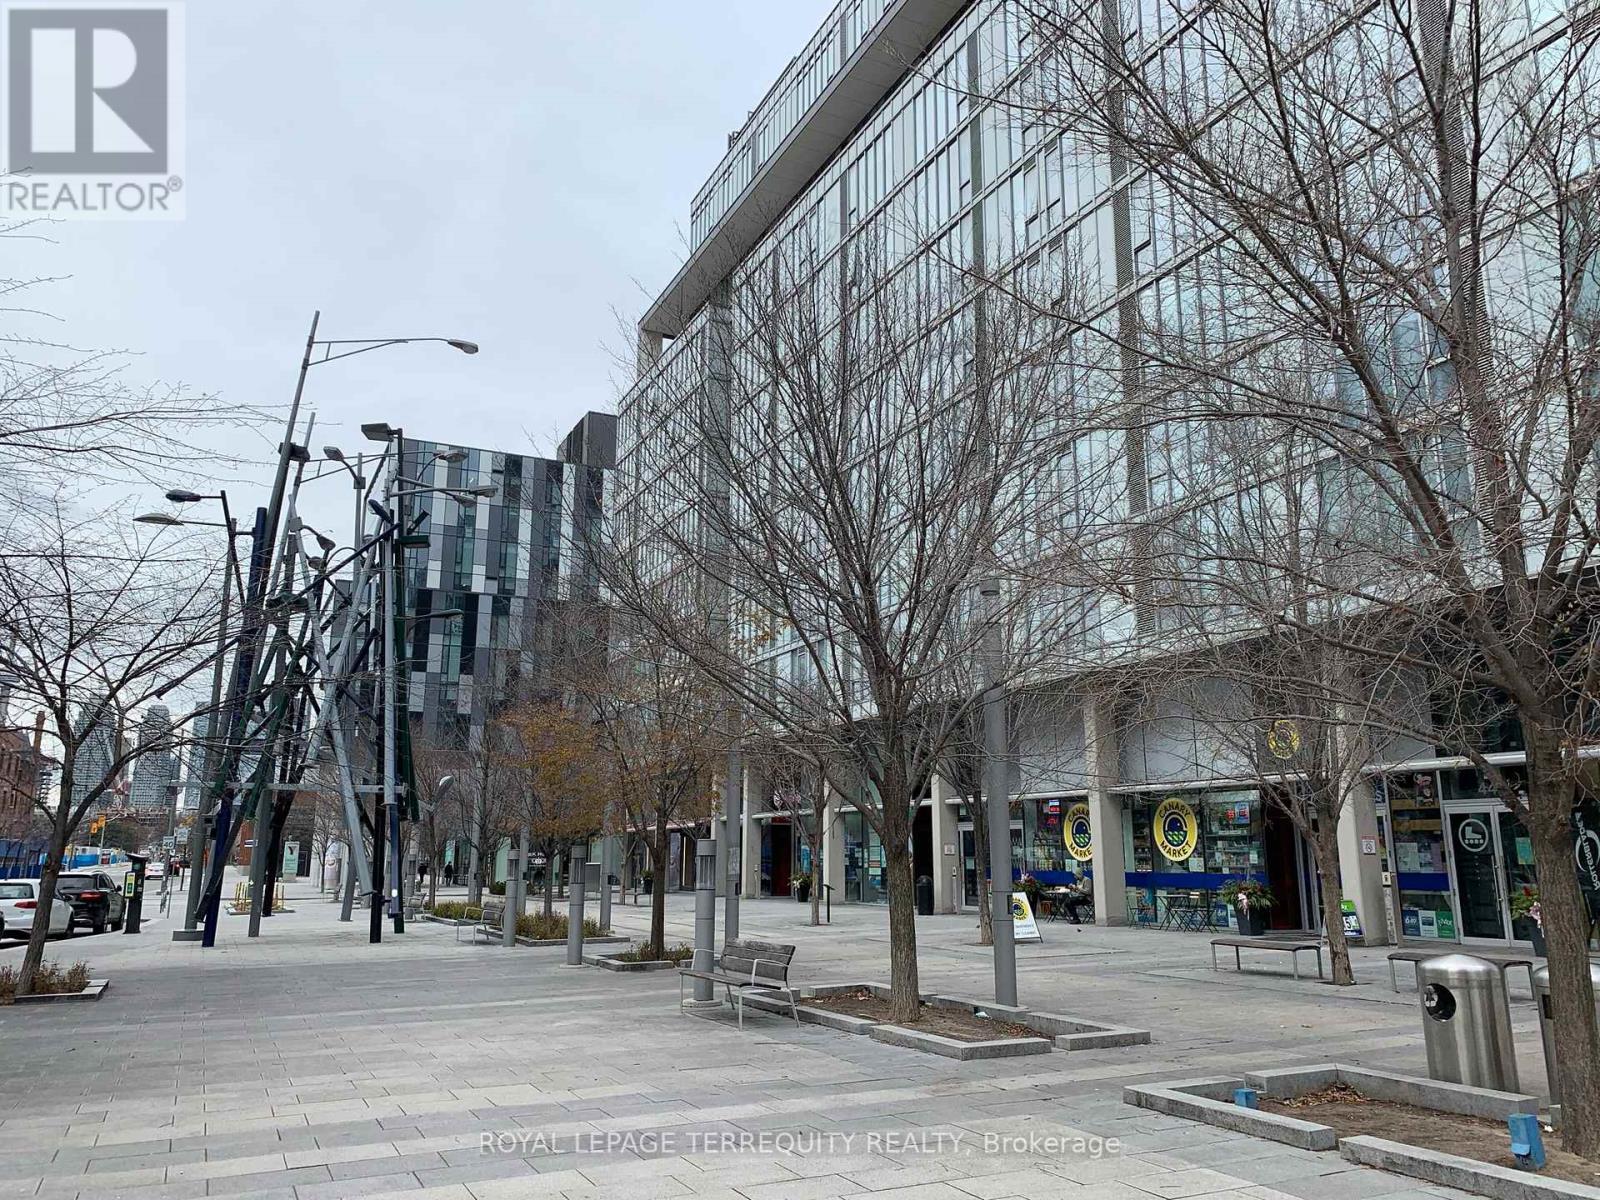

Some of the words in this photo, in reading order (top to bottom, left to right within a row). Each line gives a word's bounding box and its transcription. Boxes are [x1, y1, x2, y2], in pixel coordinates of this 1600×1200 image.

[1068, 806, 1090, 822] CANAR
[1158, 801, 1191, 818] CANARY
[1069, 843, 1093, 858] MARKE
[1160, 840, 1192, 858] MARKET
